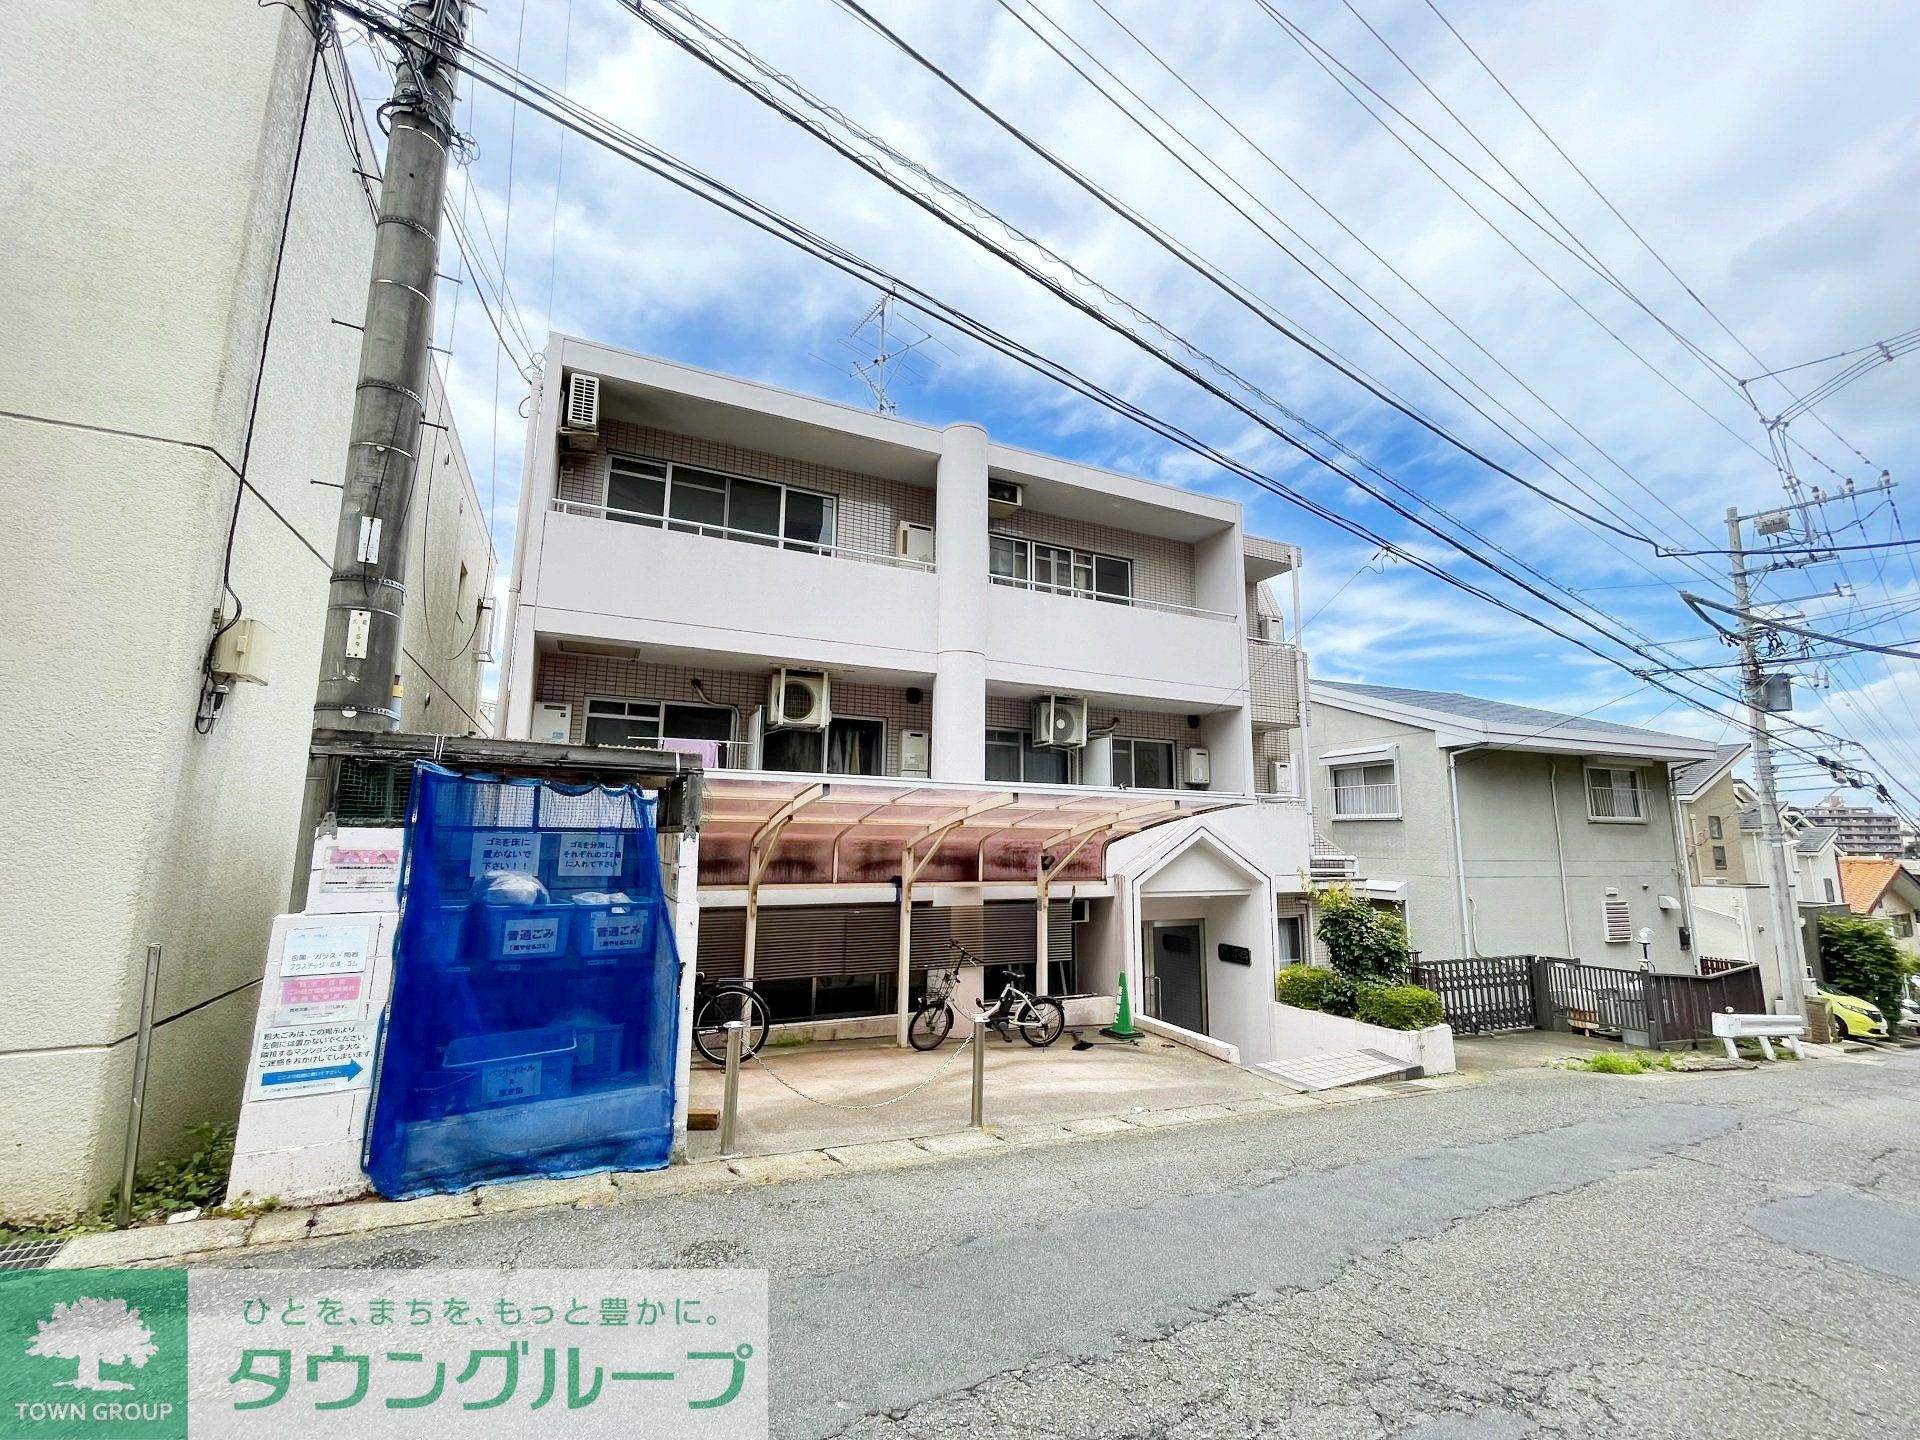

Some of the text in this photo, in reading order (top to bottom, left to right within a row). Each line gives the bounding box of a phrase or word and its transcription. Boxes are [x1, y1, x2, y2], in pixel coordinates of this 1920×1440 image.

[486, 837, 530, 847] ゴミを床に
[483, 850, 532, 859] 置かないで
[507, 928, 554, 941] 普通ごみ
